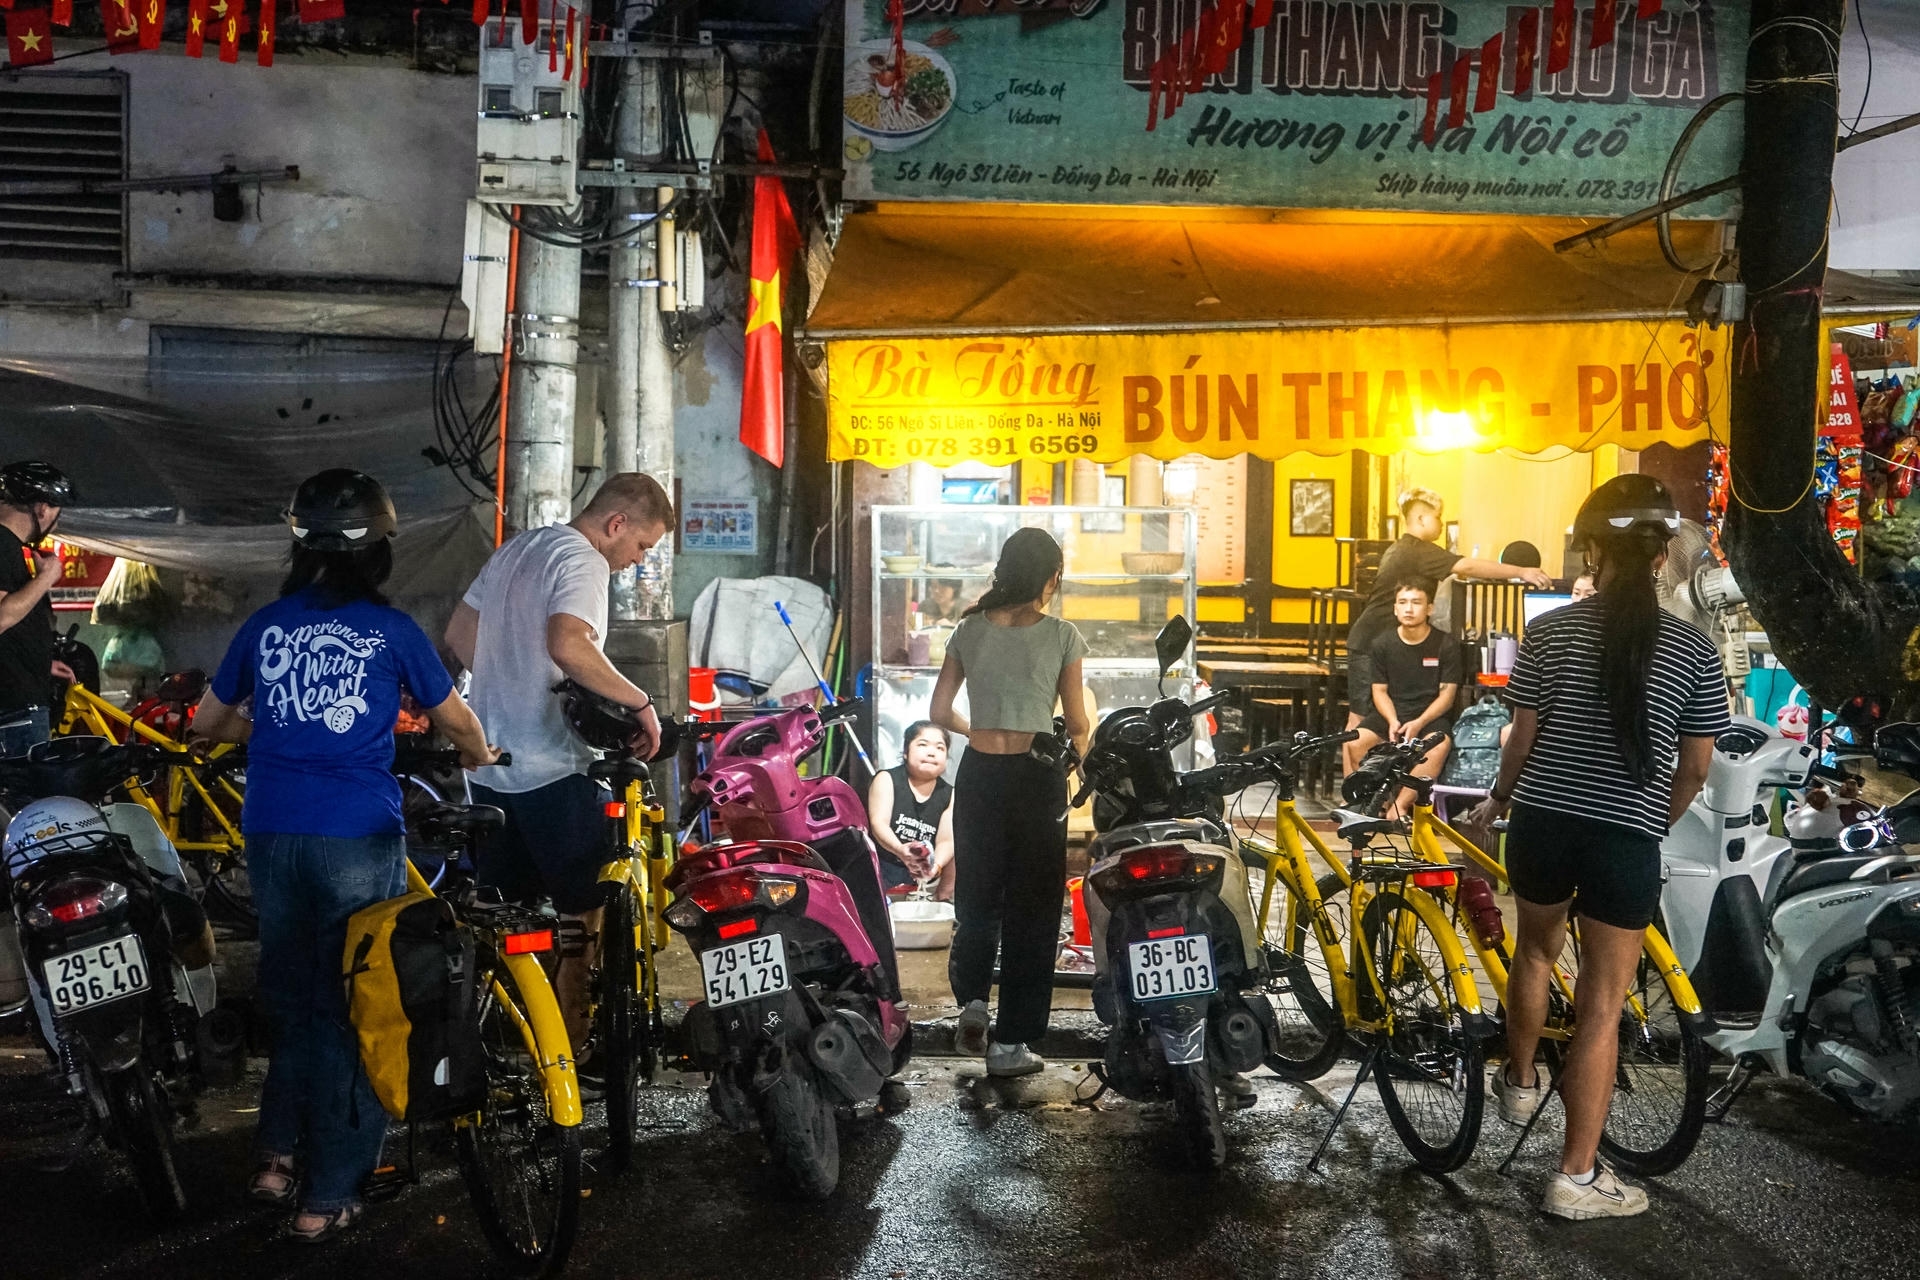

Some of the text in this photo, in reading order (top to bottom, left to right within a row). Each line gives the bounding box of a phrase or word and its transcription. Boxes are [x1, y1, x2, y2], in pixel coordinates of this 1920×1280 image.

[1258, 0, 1445, 93] THANG
[1008, 78, 1066, 102] Taste of
[1008, 106, 1062, 126] Vietnam
[1187, 104, 1346, 165] Hương
[1355, 110, 1410, 163] vị
[1407, 111, 1477, 154] Hà
[1483, 113, 1577, 166] Nội
[893, 161, 922, 182] 56
[928, 161, 968, 188] Ngô
[991, 163, 1033, 184] Liên
[1051, 163, 1101, 191] Đống
[1105, 164, 1133, 187] Đa
[1151, 166, 1179, 188] Hà
[1181, 168, 1219, 193] Nội
[1375, 171, 1418, 197] Ship
[1419, 172, 1471, 201] hàng
[1472, 177, 1530, 198] muôn
[852, 337, 1101, 409] Bà Tổng
[1123, 331, 1714, 444] BÚN THANG - PHỞ
[850, 415, 873, 430] ĐC:
[877, 415, 894, 430] 56
[945, 415, 974, 430] Liên
[1026, 413, 1044, 428] Đa
[1057, 412, 1074, 427] Hà
[1079, 411, 1101, 431] Nội
[853, 434, 1099, 457] ĐT: 078 391 6569
[259, 618, 382, 682] Experiences
[293, 650, 357, 688] With
[266, 659, 368, 722] Heart
[14, 820, 73, 851] wheels
[57, 941, 128, 984] 29-C1
[712, 938, 775, 977] 29-E2
[1138, 938, 1200, 969] 36-BC
[55, 963, 143, 1012] 996.40
[708, 963, 786, 1005] 541.29
[1135, 964, 1211, 997] 031.03
